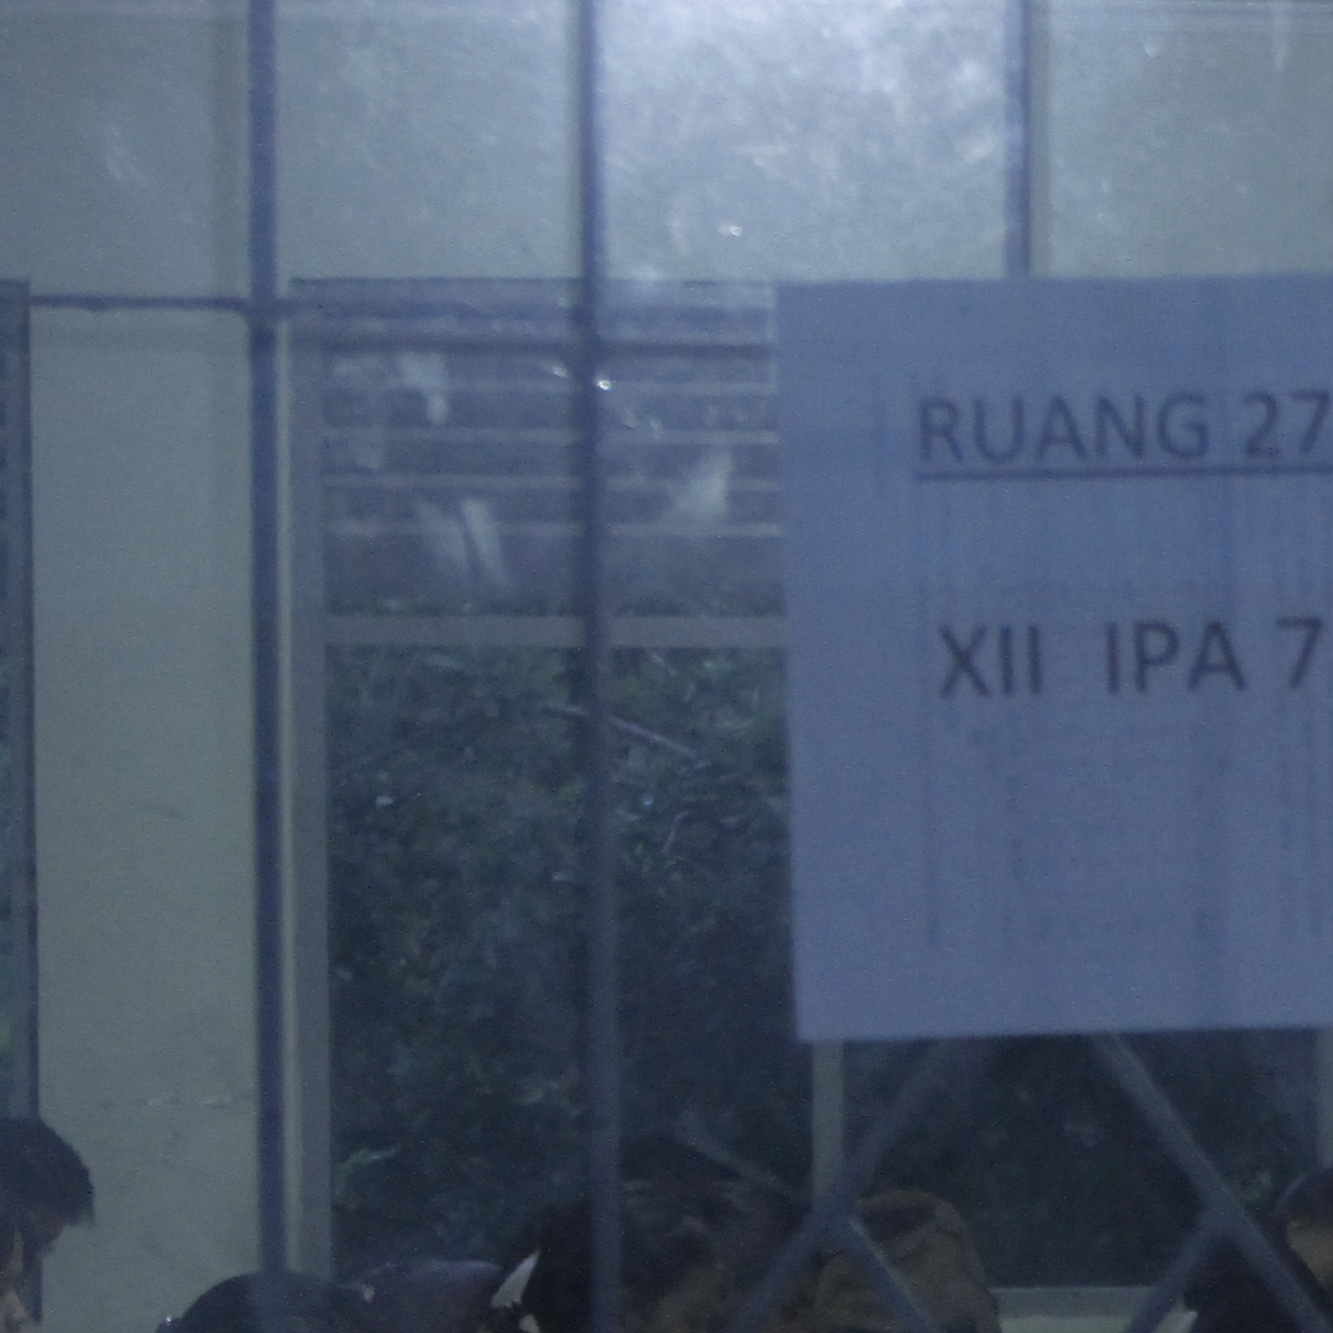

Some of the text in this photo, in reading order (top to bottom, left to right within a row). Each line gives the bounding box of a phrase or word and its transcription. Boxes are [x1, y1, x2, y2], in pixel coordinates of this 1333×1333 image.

[918, 390, 1332, 464] RUANG 27
[938, 615, 1325, 699] XII IPA 7
